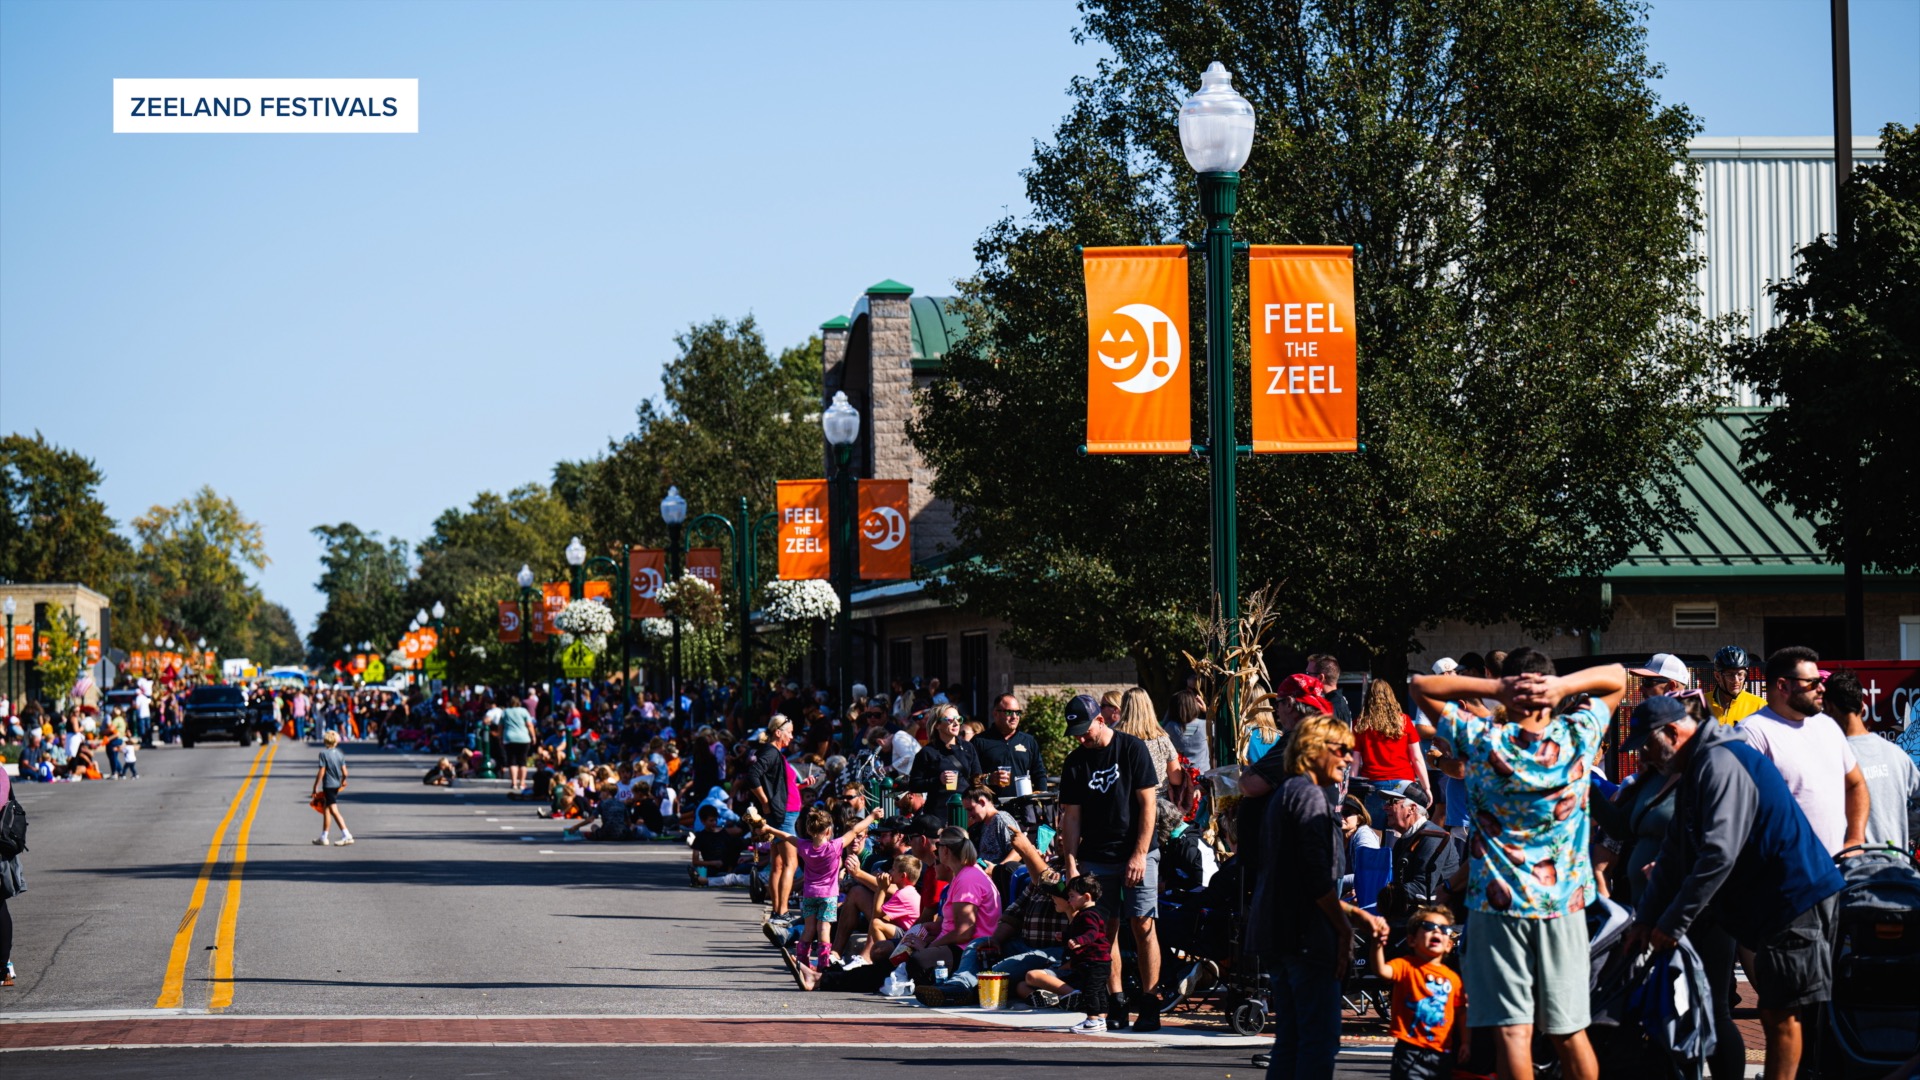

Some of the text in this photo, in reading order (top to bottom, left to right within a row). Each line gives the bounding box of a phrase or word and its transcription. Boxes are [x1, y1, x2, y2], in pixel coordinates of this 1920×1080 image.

[1264, 303, 1344, 334] FEEL
[1284, 342, 1318, 358] THE
[1266, 366, 1343, 395] ZEEL
[784, 507, 824, 524] FEEL
[794, 526, 811, 535] THE
[785, 538, 823, 553] ZEEL
[690, 566, 717, 578] FEEL
